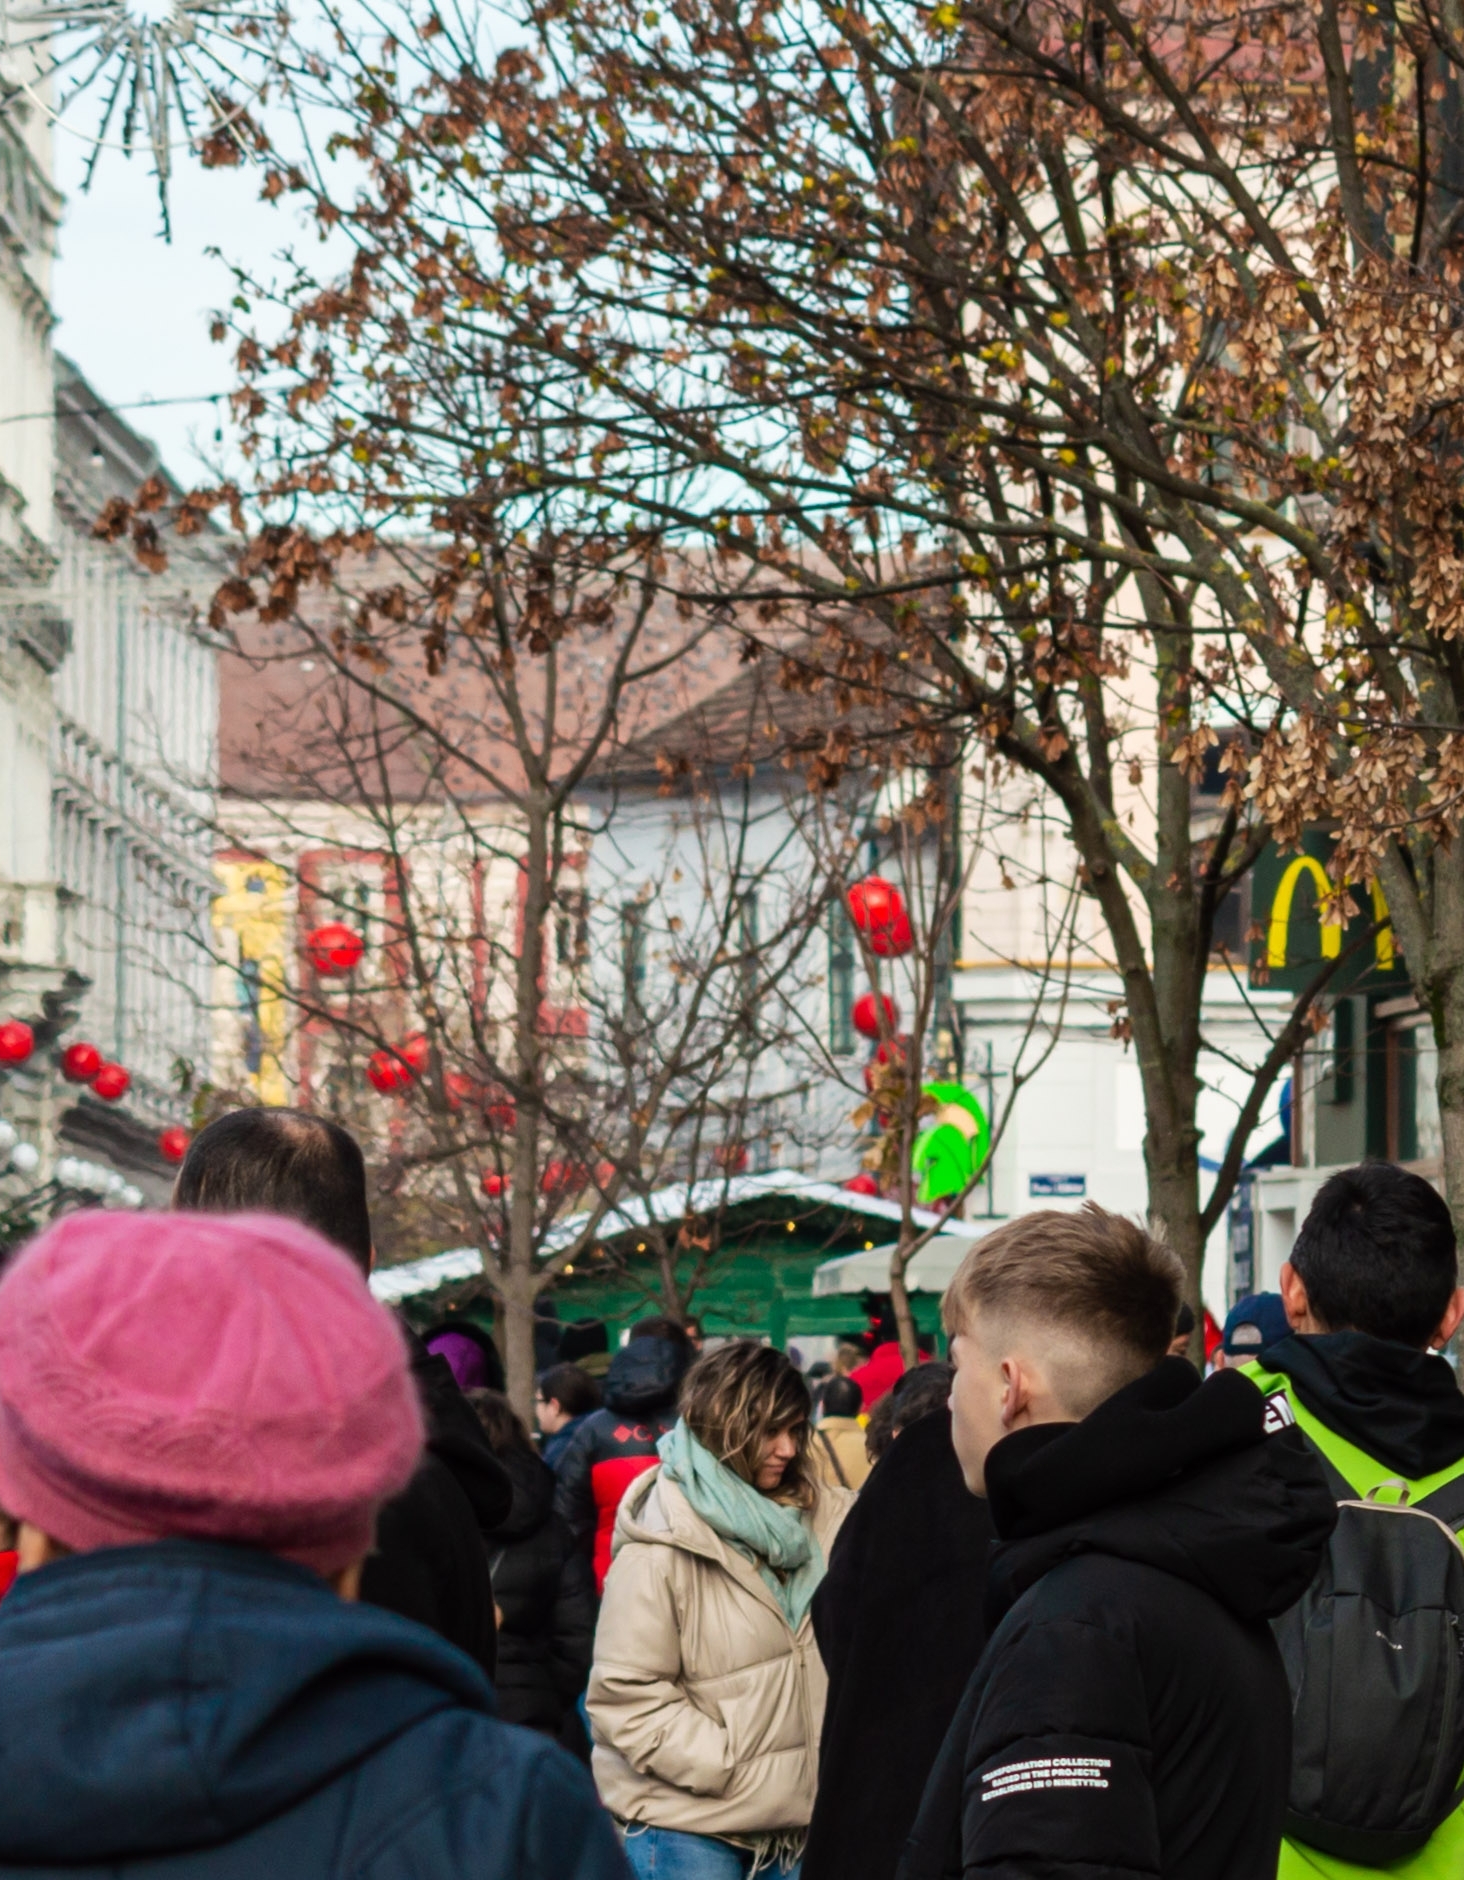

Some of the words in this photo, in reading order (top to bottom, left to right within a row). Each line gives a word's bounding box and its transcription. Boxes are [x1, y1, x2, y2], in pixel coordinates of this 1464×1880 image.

[1052, 1758, 1111, 1768] COLLECTION
[1020, 1772, 1031, 1780] IN
[1031, 1769, 1050, 1779] THE
[1051, 1768, 1101, 1777] PROJECTS
[1033, 1780, 1044, 1789] IN
